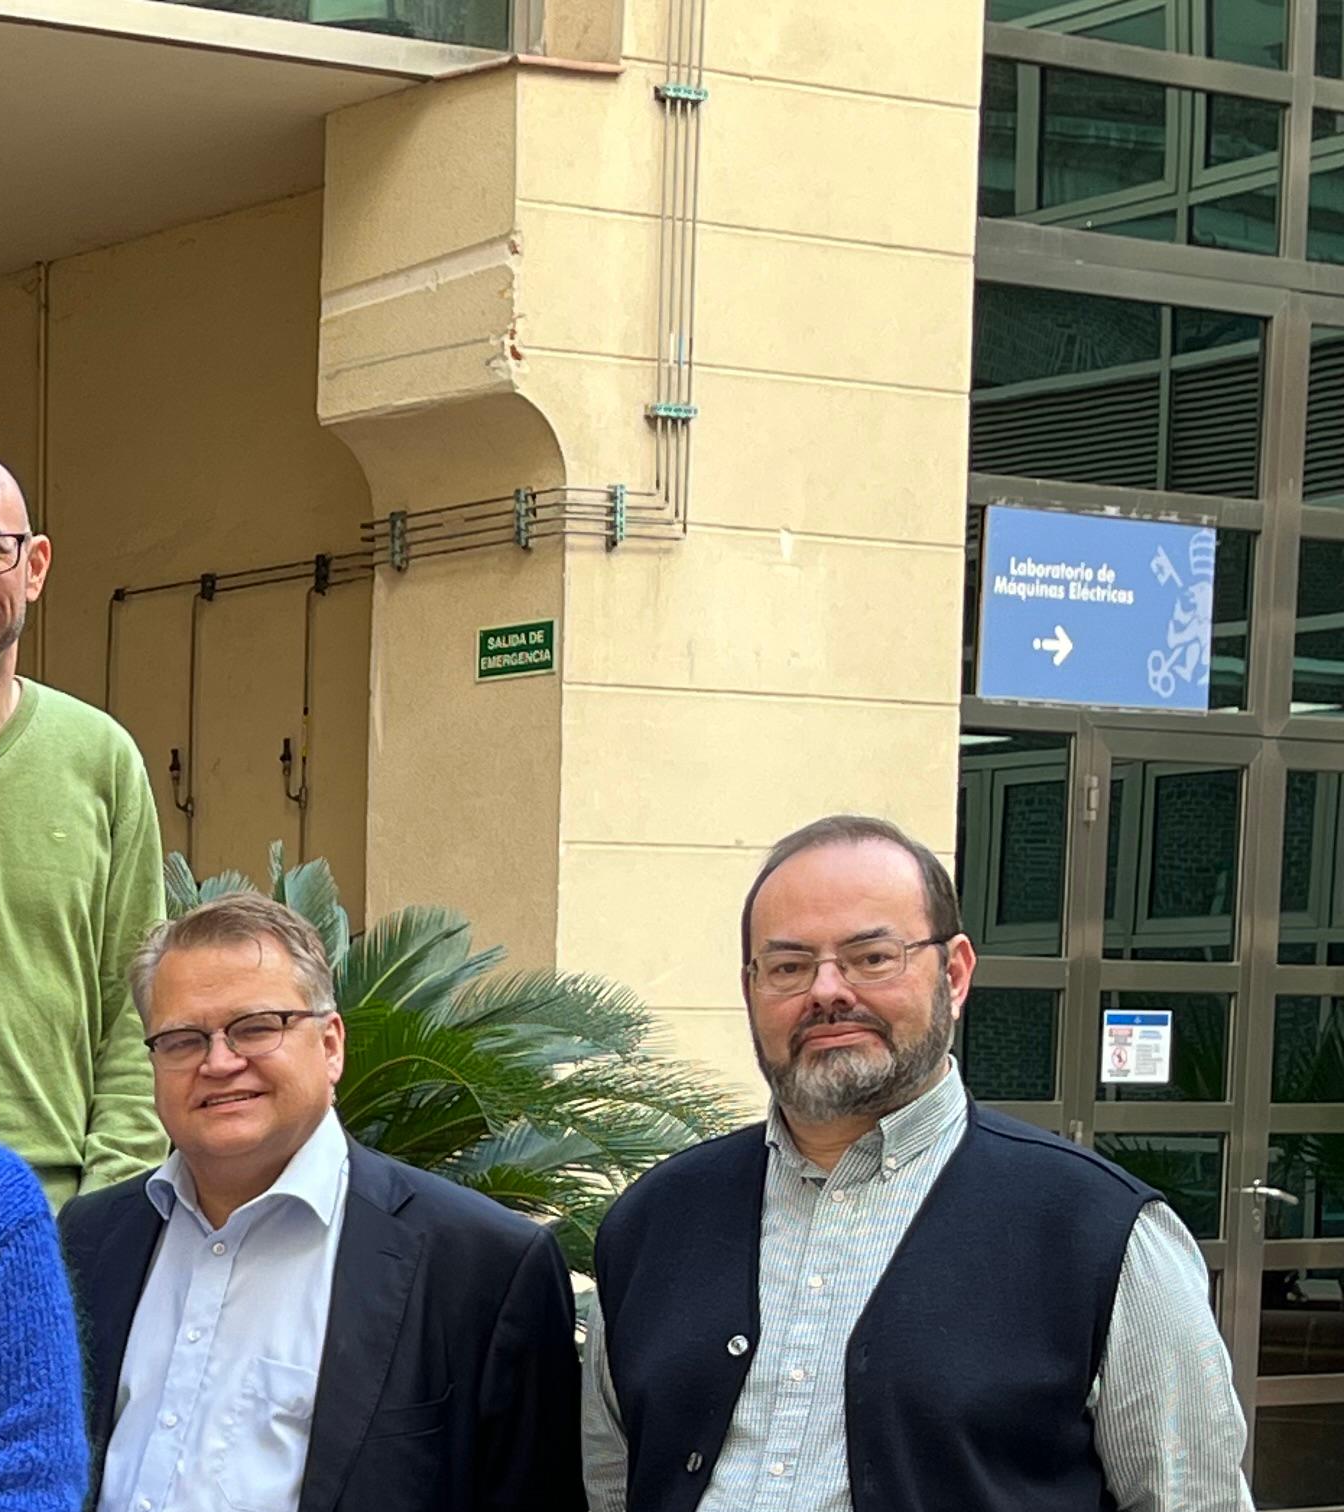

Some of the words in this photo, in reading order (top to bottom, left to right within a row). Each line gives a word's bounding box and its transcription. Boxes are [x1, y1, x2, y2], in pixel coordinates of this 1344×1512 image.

[1009, 556, 1094, 581] Laboratorio
[1097, 563, 1116, 583] de
[994, 575, 1065, 601] Máquinas
[1069, 581, 1134, 605] Eléctricas
[487, 632, 527, 650] SALIDA
[529, 630, 545, 644] DE
[481, 648, 551, 670] EMERGENCIA
